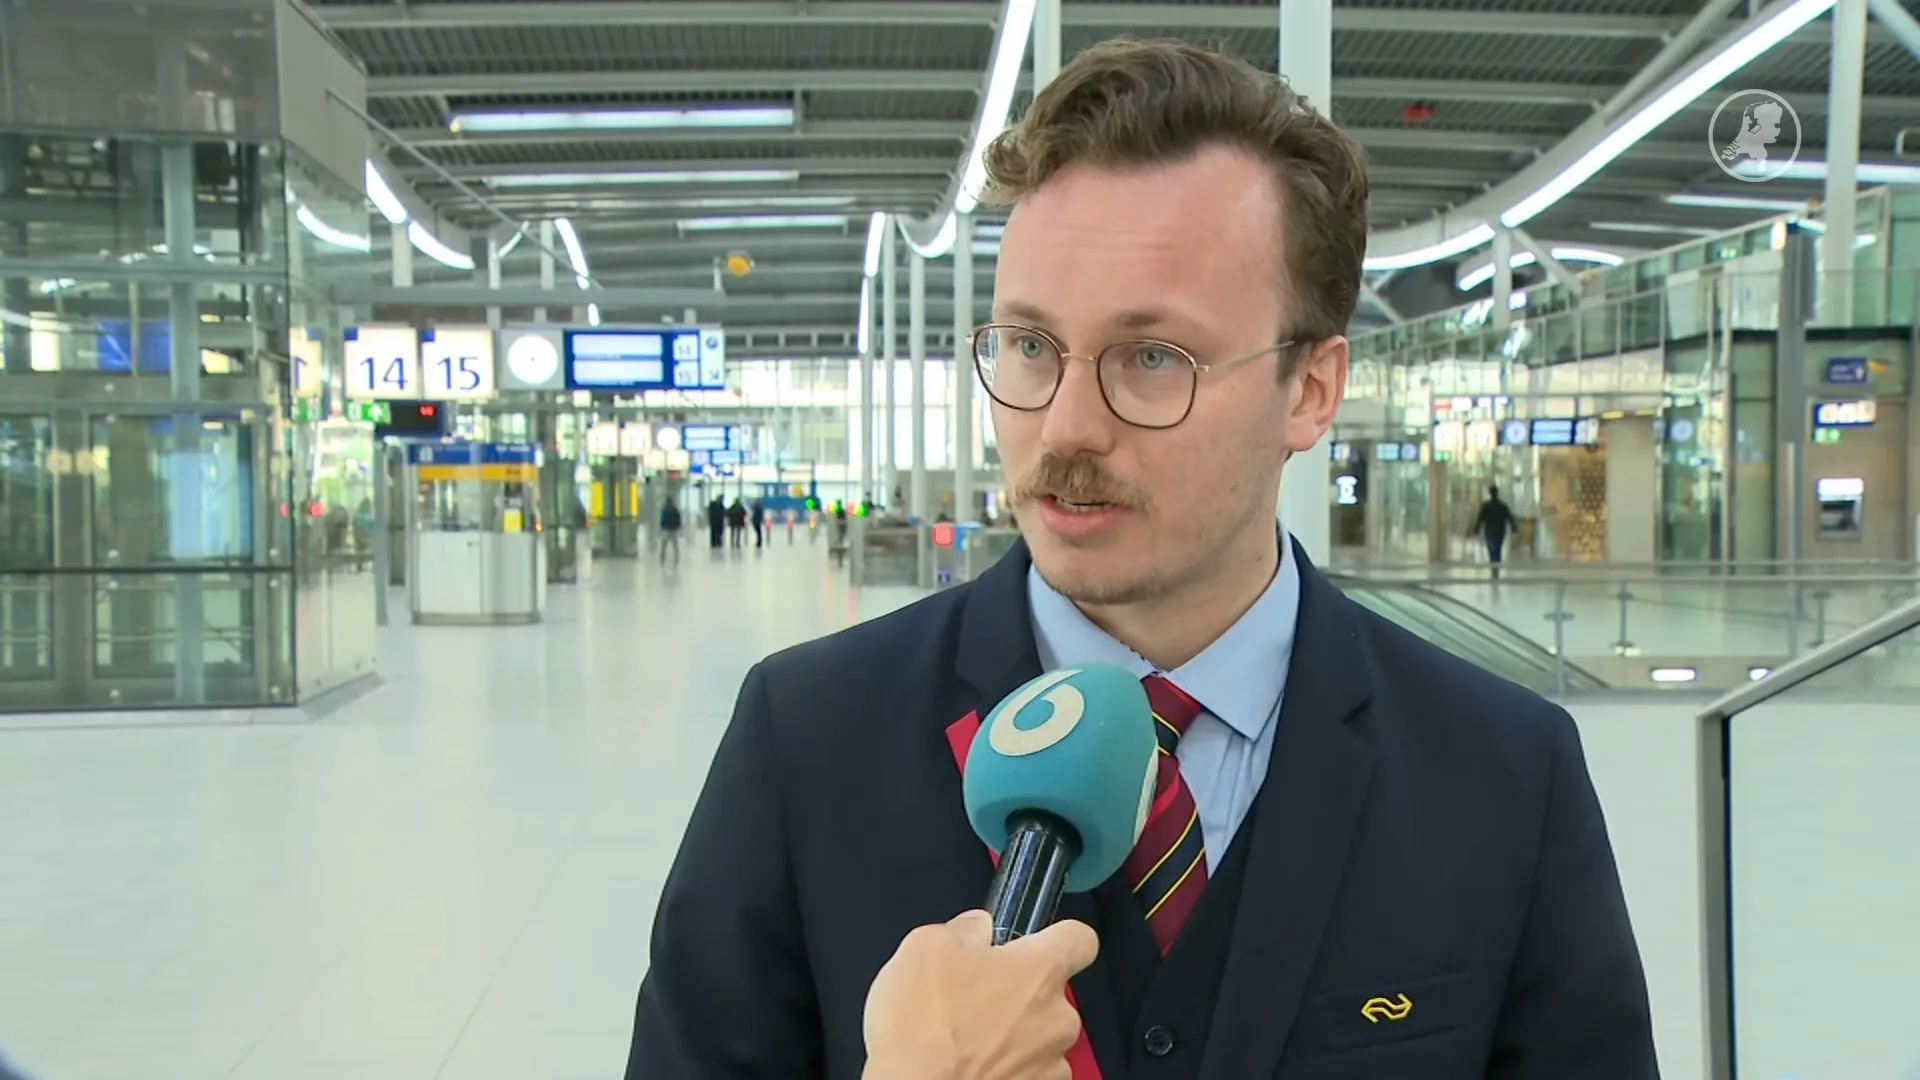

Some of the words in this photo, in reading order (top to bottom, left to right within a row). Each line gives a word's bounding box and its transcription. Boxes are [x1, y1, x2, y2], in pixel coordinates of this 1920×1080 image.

[360, 356, 409, 391] 14
[437, 356, 481, 391] 15
[988, 668, 1086, 757] 6
